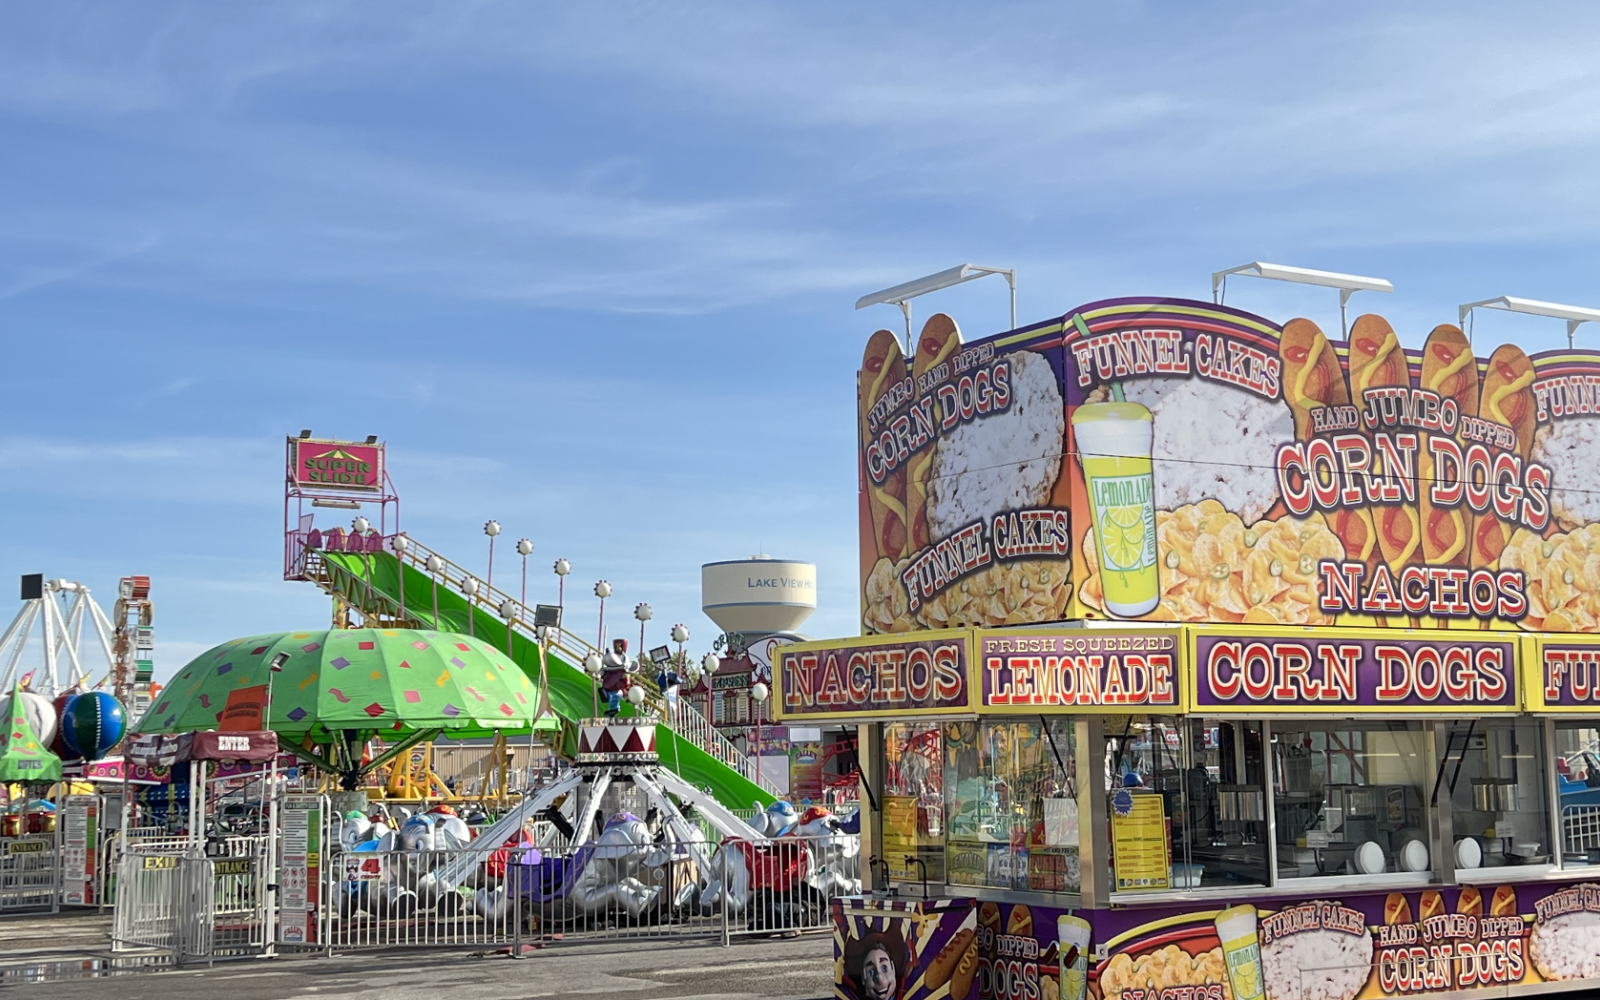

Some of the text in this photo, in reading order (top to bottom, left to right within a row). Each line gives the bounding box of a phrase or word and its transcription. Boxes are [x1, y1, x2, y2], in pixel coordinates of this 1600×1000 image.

[1073, 329, 1281, 398] FUNNEL CAKES
[868, 342, 995, 433] JUMBO HAND DIPPED
[867, 362, 1012, 483] CORN DOGS
[1312, 388, 1515, 451] HAND JUMBO DIPPED
[305, 458, 370, 473] SUPER
[309, 470, 366, 485] SLIDE
[1277, 433, 1551, 530] CORN DOGS
[903, 510, 1069, 611] FUNNEL CAKES
[747, 577, 777, 588] LAKE
[780, 578, 803, 589] VIEW
[1321, 561, 1526, 616] NACHOS
[985, 637, 1174, 654] FRESH SQUEEZED
[786, 644, 962, 707] NACHOS
[987, 654, 1174, 706] LEMONADE
[1207, 641, 1506, 702] CORN DOGS
[218, 736, 250, 751] ENTER
[12, 843, 41, 852] ENTRANCE
[145, 856, 177, 869] EXIT
[214, 860, 249, 874] NTRANCE
[361, 858, 381, 874] 4
[1262, 904, 1364, 943] FUNNEL CAKES
[1535, 889, 1583, 923] FUNNEL
[996, 935, 1038, 960] DIPPED
[1379, 913, 1523, 947] HAND JUMBO DIPPED
[979, 957, 1040, 1000] DOGS
[1379, 939, 1524, 993] CORN DOGS
